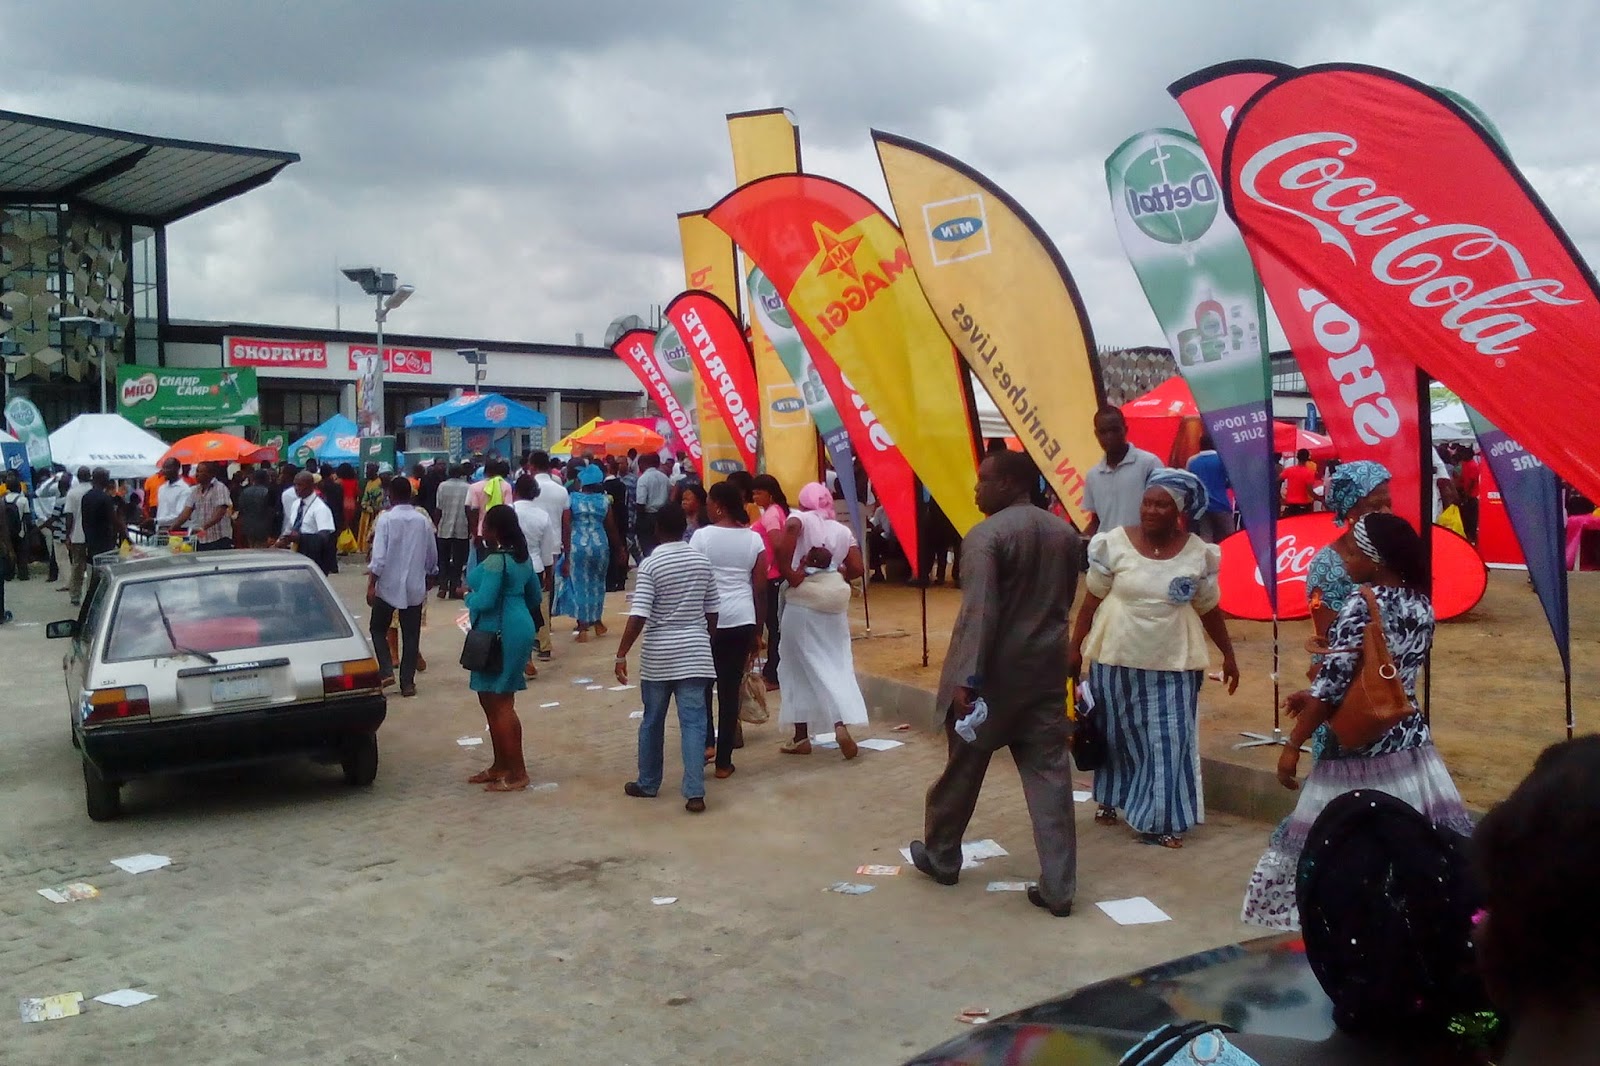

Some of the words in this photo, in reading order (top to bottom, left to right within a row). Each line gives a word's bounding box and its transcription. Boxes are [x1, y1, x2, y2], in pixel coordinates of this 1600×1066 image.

[1240, 131, 1584, 356] Coca-Cola
[233, 344, 324, 362] SHOPRITE
[160, 376, 200, 387] CHAMP
[124, 384, 155, 399] MILO
[176, 386, 210, 396] CAMP
